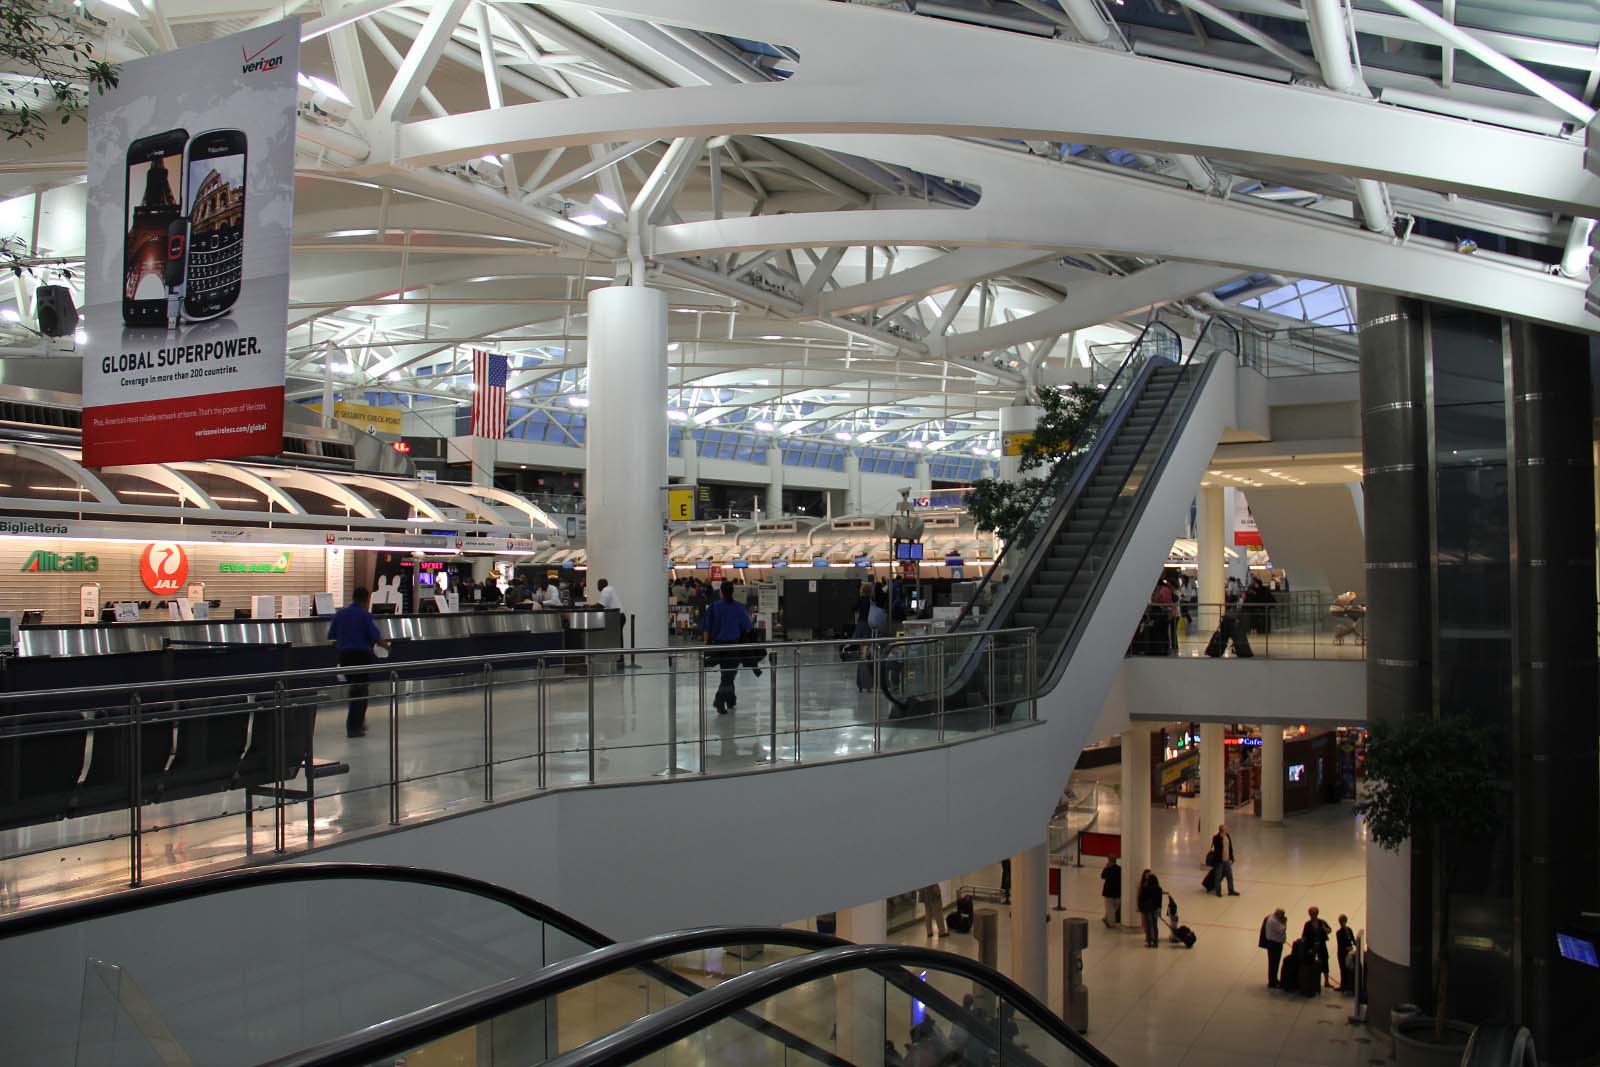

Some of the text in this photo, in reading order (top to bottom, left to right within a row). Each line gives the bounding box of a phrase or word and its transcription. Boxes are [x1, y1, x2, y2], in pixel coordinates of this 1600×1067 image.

[242, 54, 283, 74] verizon
[102, 336, 262, 374] GLOBAL SUPERPOWER.
[120, 365, 239, 387] Coverage in more than 200 countries.
[194, 422, 267, 437] verizonwireless.com/global
[680, 503, 687, 517] E
[0, 522, 68, 534] Biglietteria
[20, 549, 99, 573] Alitalia
[219, 562, 273, 573] EVA AIR
[153, 579, 180, 589] JAL
